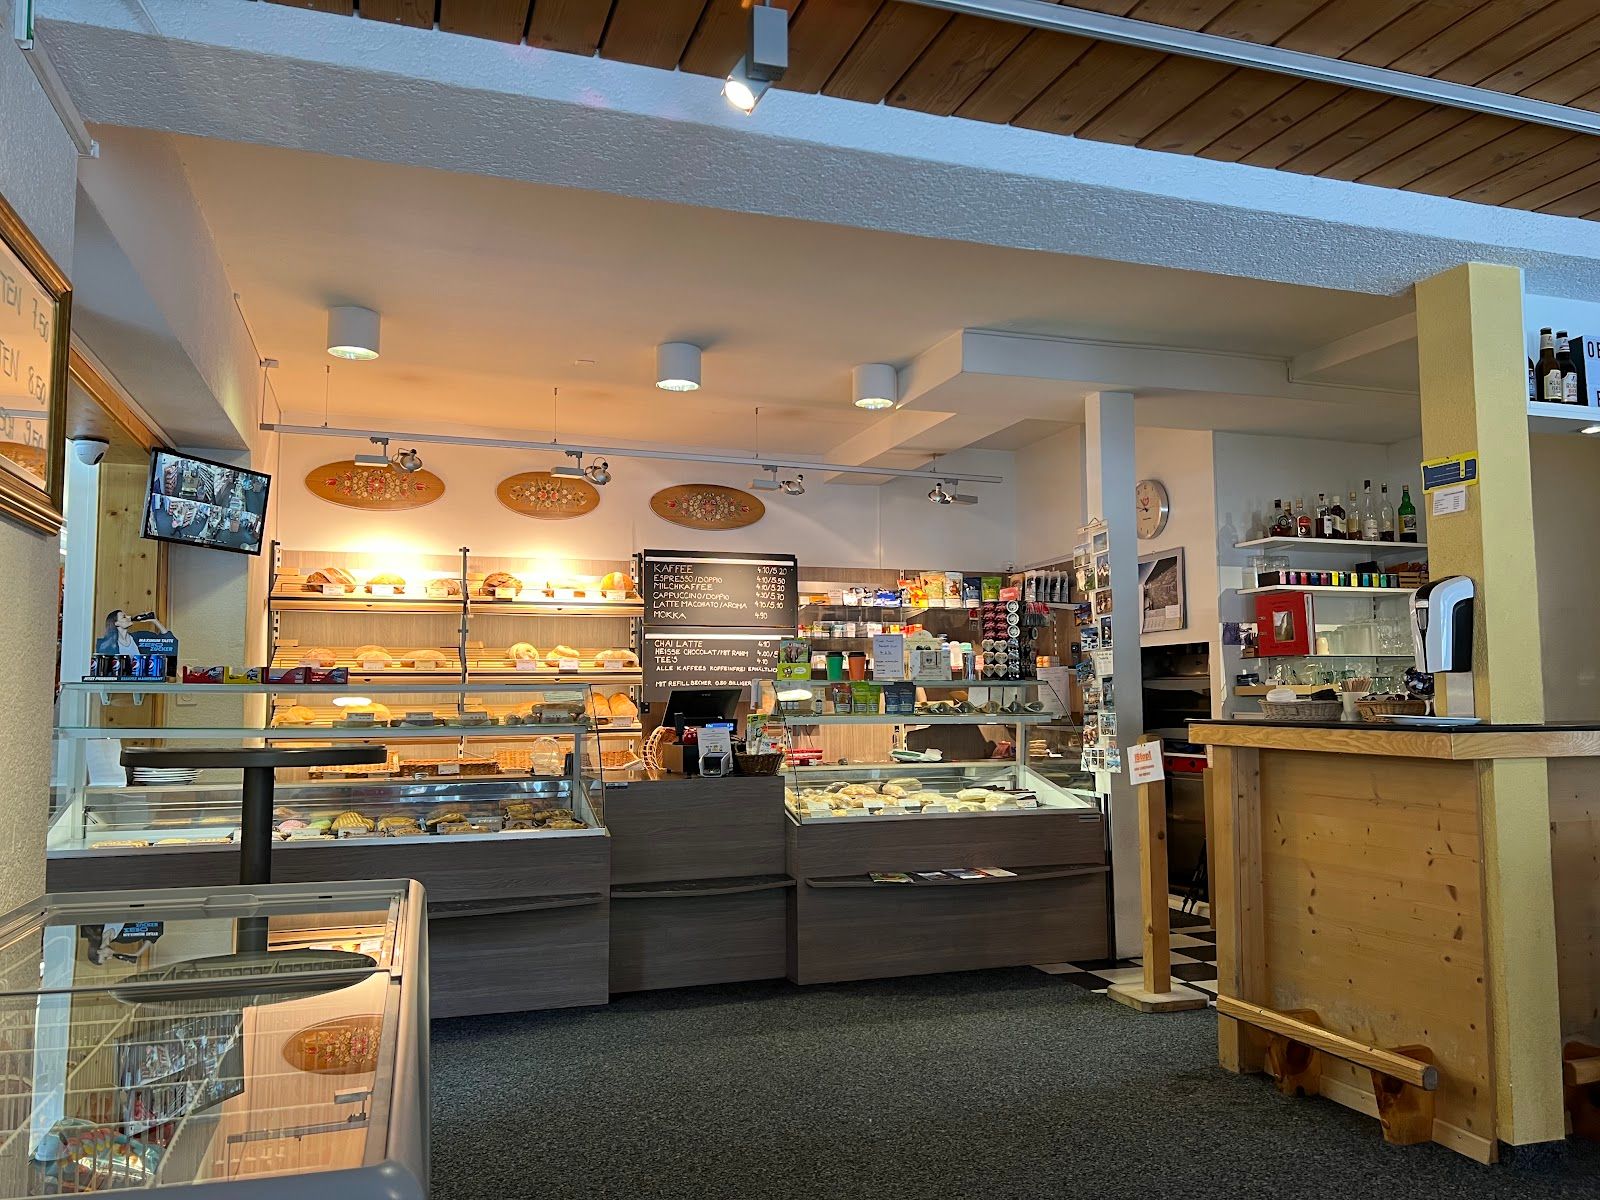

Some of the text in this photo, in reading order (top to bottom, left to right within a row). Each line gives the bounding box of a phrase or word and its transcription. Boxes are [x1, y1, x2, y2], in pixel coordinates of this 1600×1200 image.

[653, 563, 694, 574] KAFFEE
[653, 582, 713, 591] MILCHKAFFEE
[653, 600, 680, 609] LATTE
[653, 610, 687, 620] MOKKA
[654, 639, 673, 648] CHAI
[675, 639, 703, 648] LATTE
[654, 647, 681, 656] HEISSE
[731, 649, 749, 658] RAHM
[654, 656, 678, 664] TEE'S
